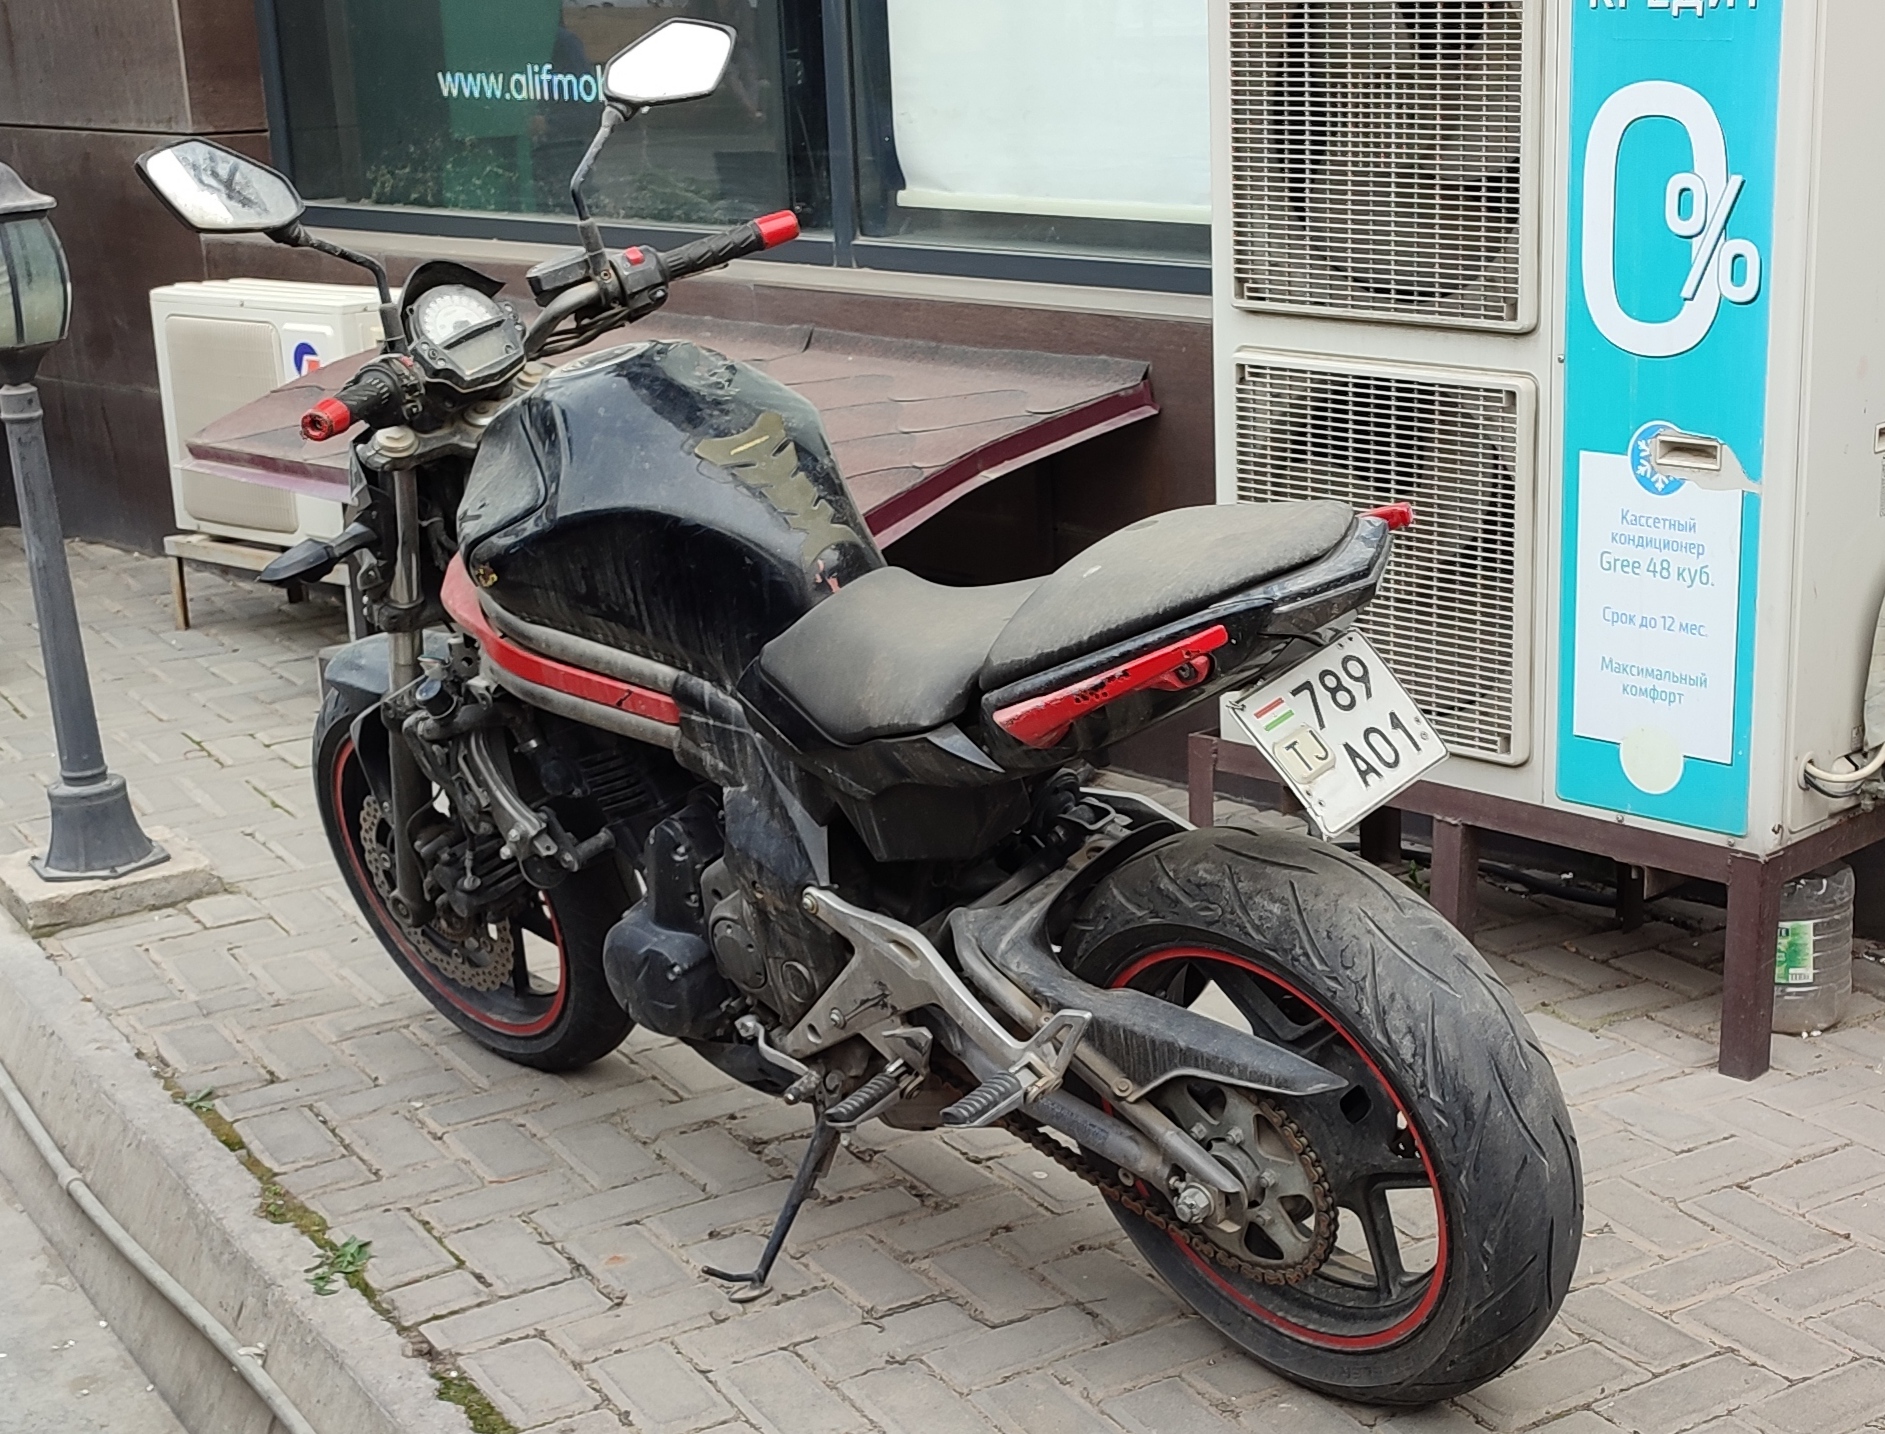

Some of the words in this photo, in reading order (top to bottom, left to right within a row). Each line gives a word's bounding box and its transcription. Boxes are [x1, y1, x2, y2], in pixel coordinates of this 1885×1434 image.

[1581, 79, 1761, 357] 0%
[1620, 507, 1697, 534] Кассетный
[1611, 531, 1706, 559] кондиционер
[1599, 550, 1642, 576] Gree
[1646, 557, 1671, 580] 48
[1676, 564, 1715, 589] куб.
[1602, 606, 1636, 627] Срок
[1638, 615, 1658, 630] до
[1660, 615, 1676, 632] 12
[1678, 620, 1709, 638] мес.
[1600, 655, 1709, 689] Максимальный
[1290, 655, 1372, 730] 789
[1621, 683, 1685, 707] комфорт
[1284, 729, 1329, 771] TJ
[1341, 710, 1422, 788] A01
